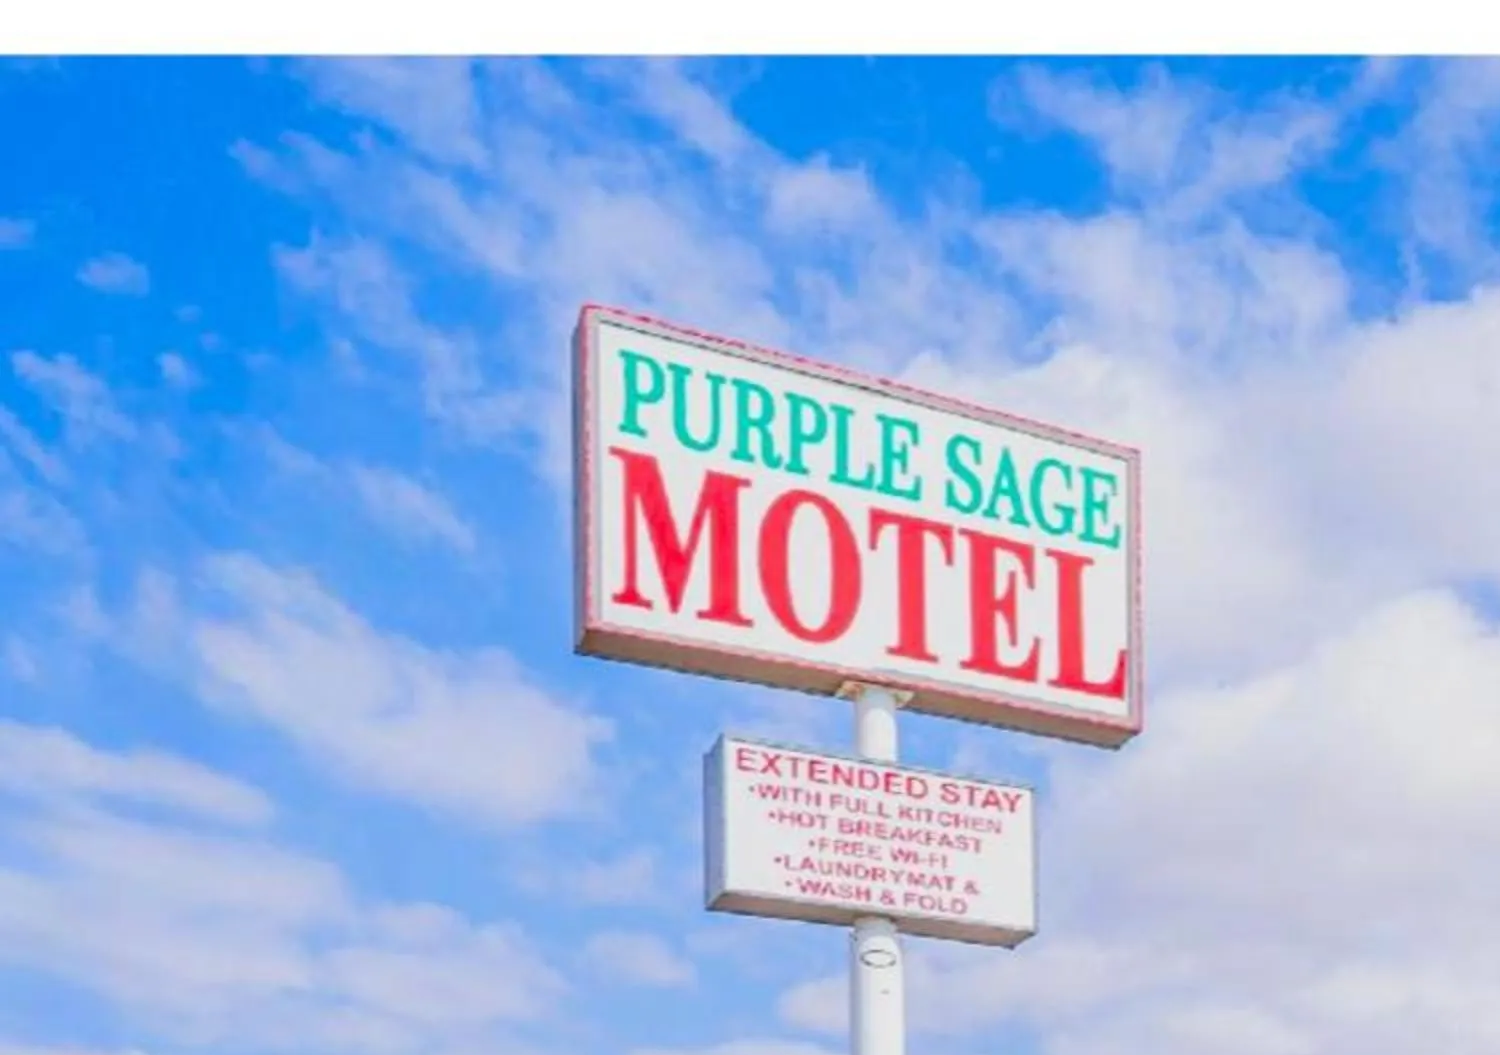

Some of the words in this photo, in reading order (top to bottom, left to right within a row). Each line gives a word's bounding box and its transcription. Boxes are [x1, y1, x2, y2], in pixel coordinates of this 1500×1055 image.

[618, 349, 922, 502] PURPLE
[945, 434, 1121, 549] SAGE
[608, 445, 1127, 700] MOTEL
[735, 747, 929, 800] EXTENDED
[939, 781, 1024, 814] STAY
[829, 793, 893, 820] FULL
[898, 805, 1003, 835] KITCHEN
[837, 817, 982, 854] BREAKFAST
[890, 847, 949, 870] WI-FI
[879, 889, 896, 906] &
[903, 892, 968, 915] FOLD
[963, 880, 981, 896] &
